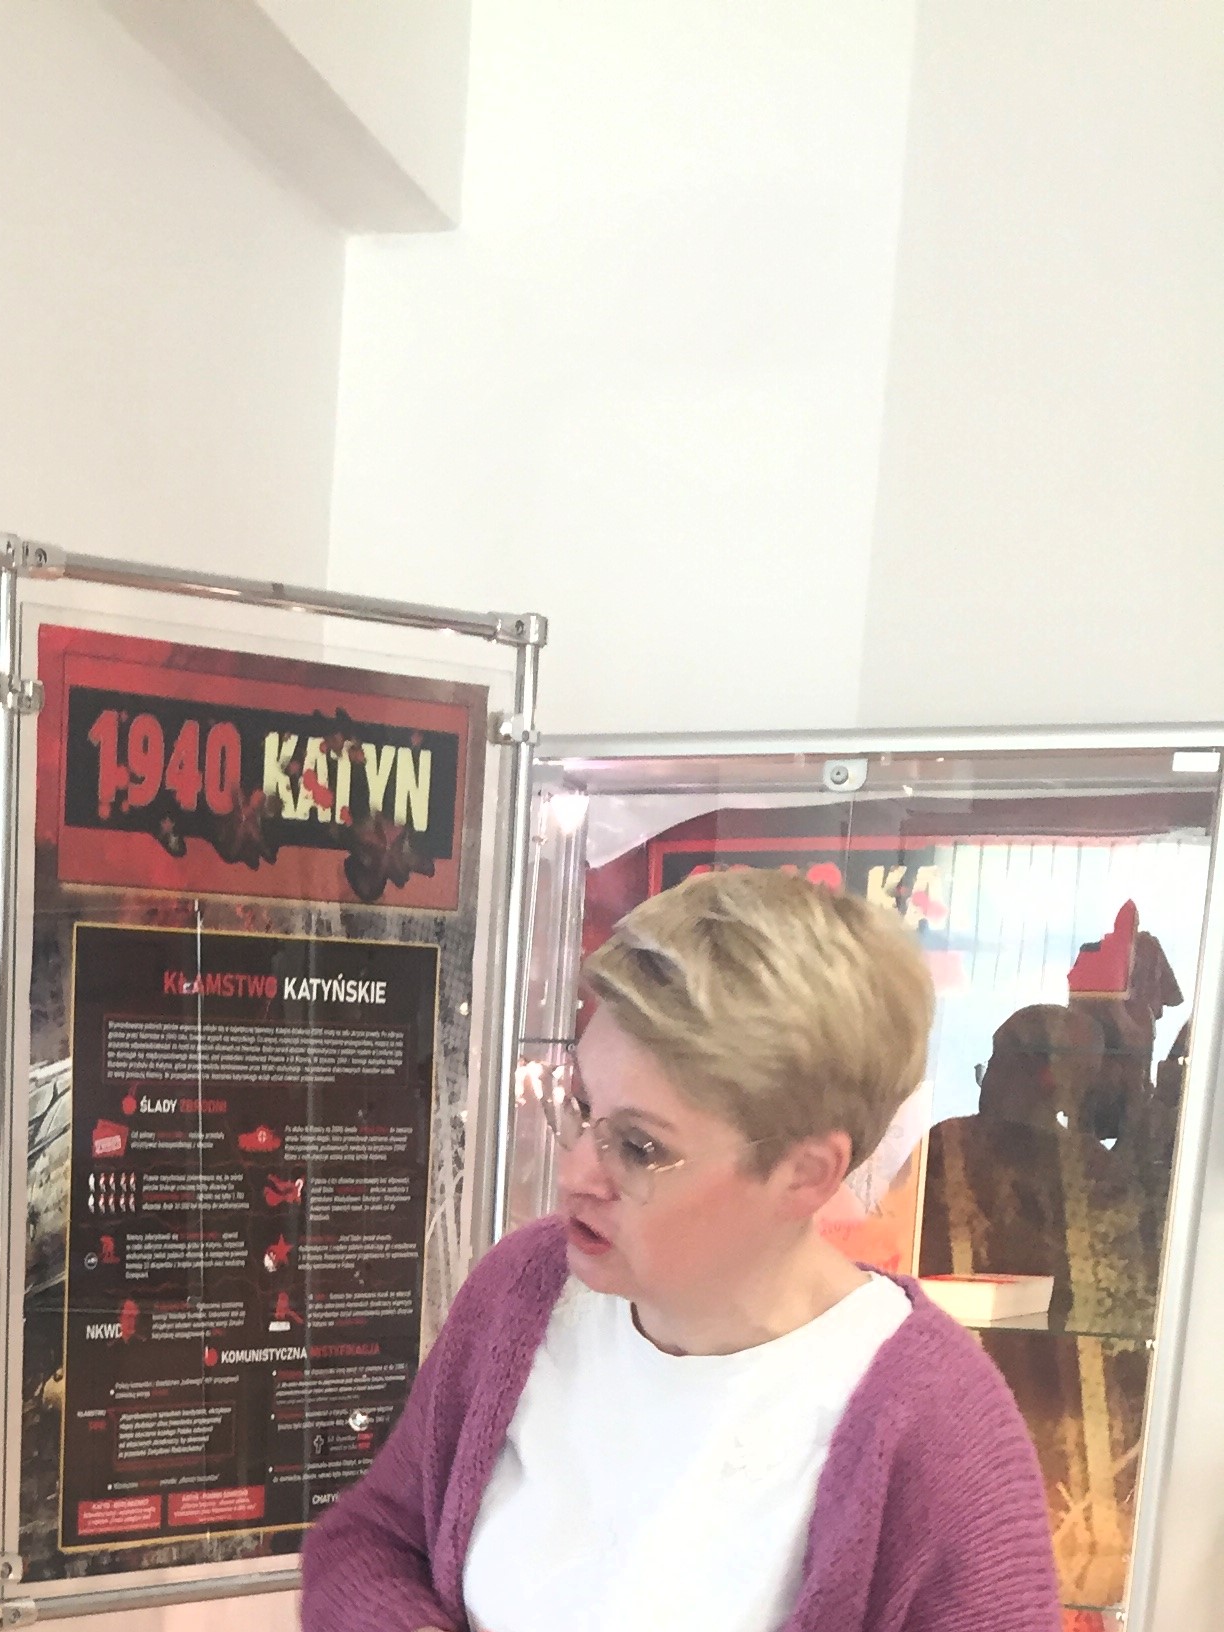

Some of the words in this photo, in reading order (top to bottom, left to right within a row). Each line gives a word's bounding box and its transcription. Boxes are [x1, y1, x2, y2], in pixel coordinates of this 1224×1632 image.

[89, 709, 242, 814] 1940
[284, 973, 387, 1004] KATYŃSKIE
[140, 1095, 178, 1113] ŚLADY
[86, 1323, 123, 1340] NKWD
[221, 1347, 307, 1365] KOMUNISTYCZNA
